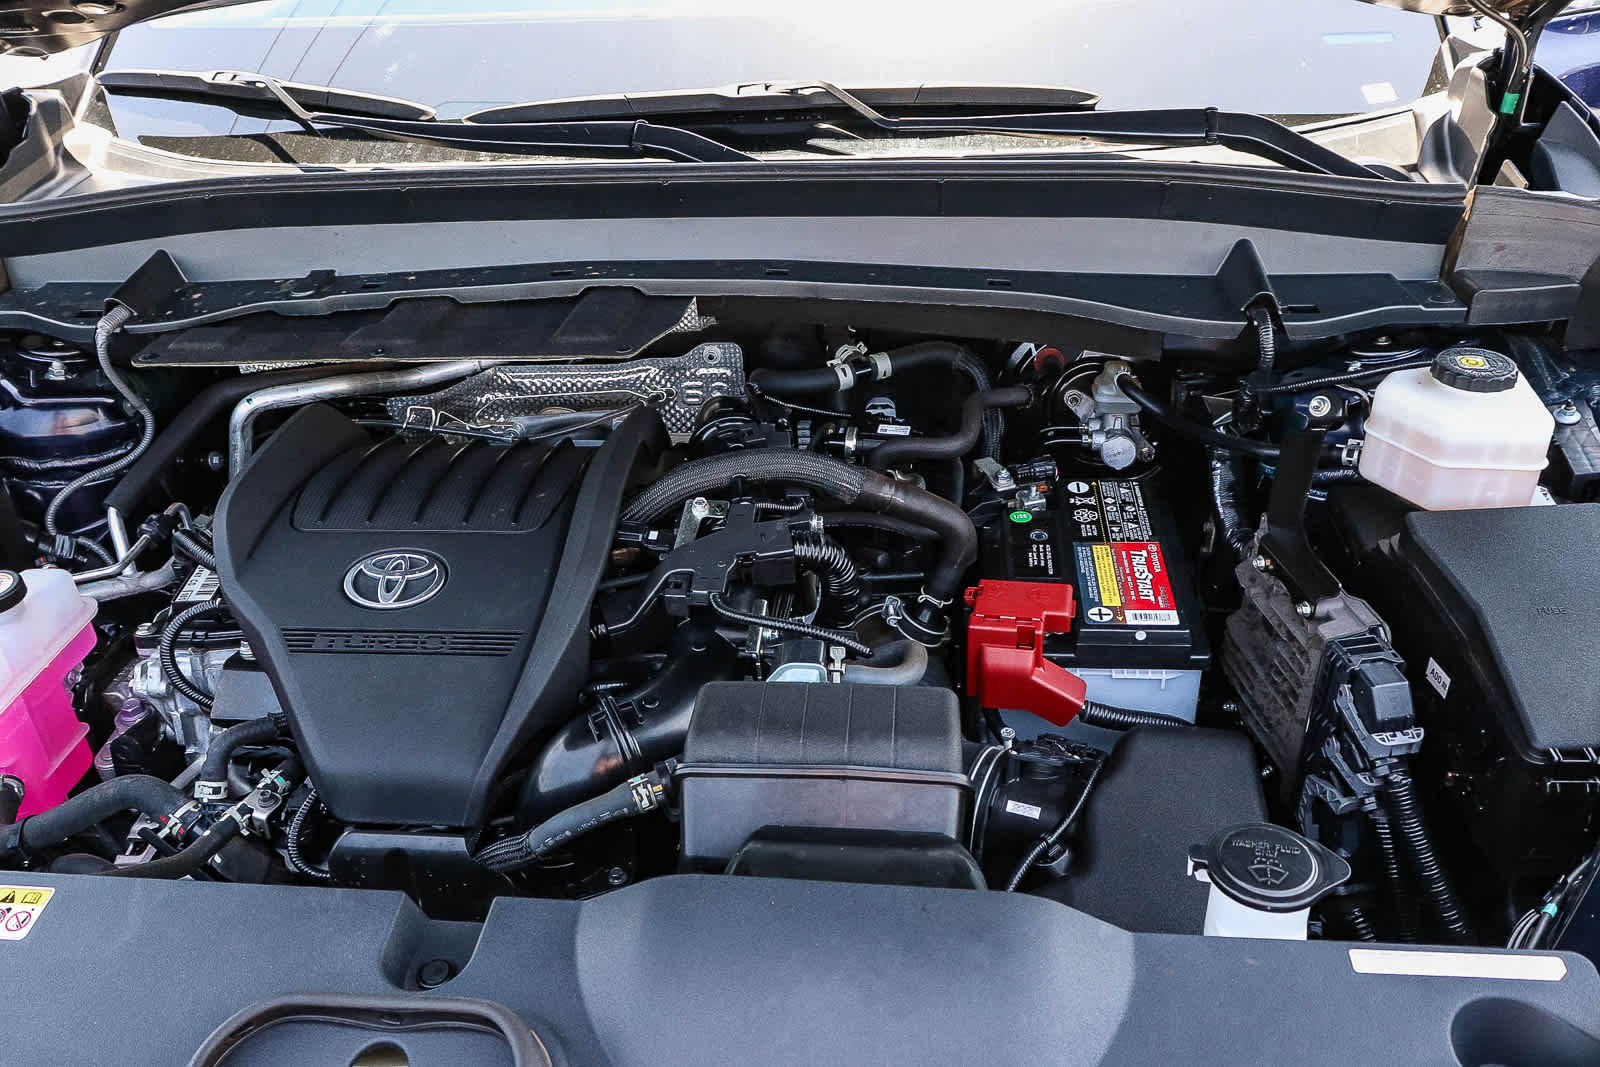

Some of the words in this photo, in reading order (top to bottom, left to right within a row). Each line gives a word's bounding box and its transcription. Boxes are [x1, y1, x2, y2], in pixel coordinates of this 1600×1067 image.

[1151, 552, 1162, 573] TOYOTA
[312, 632, 450, 651] TURBO
[1231, 839, 1270, 849] WASHER
[1275, 844, 1301, 855] FLUID
